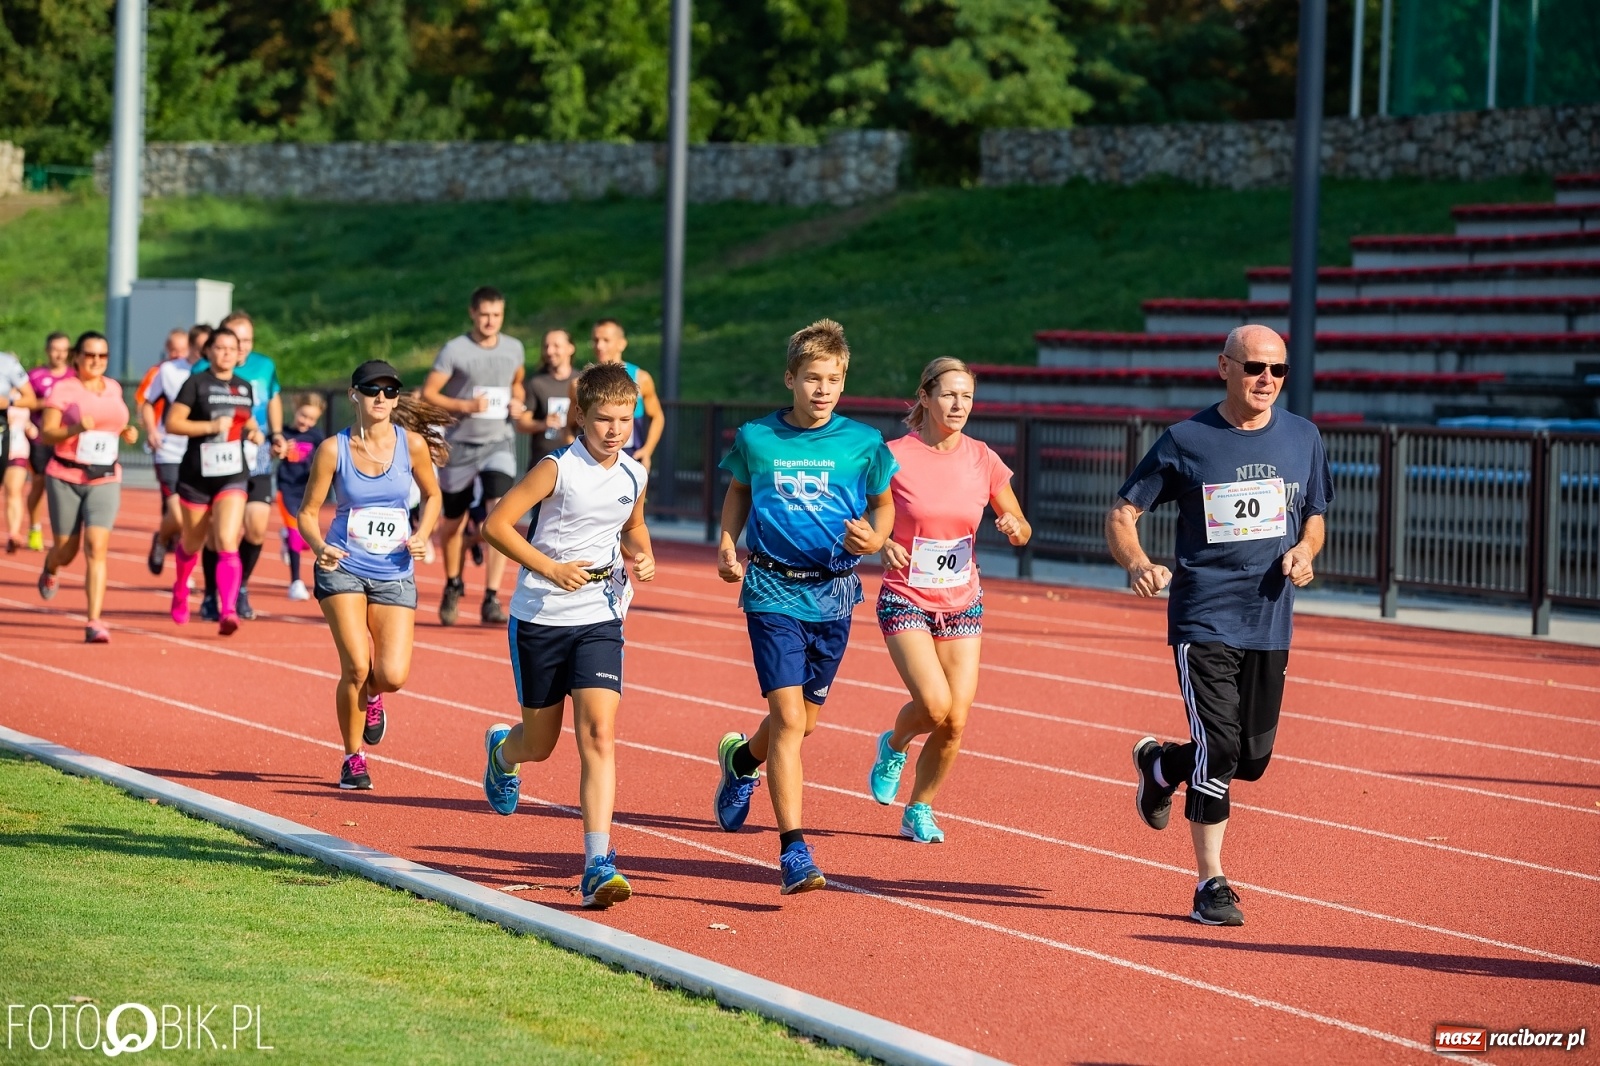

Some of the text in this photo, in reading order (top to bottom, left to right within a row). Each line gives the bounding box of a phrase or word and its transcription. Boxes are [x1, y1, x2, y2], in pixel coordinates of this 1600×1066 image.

[1236, 463, 1278, 481] NIKE
[1234, 498, 1260, 518] 20
[367, 521, 396, 537] 149
[936, 554, 957, 571] 90
